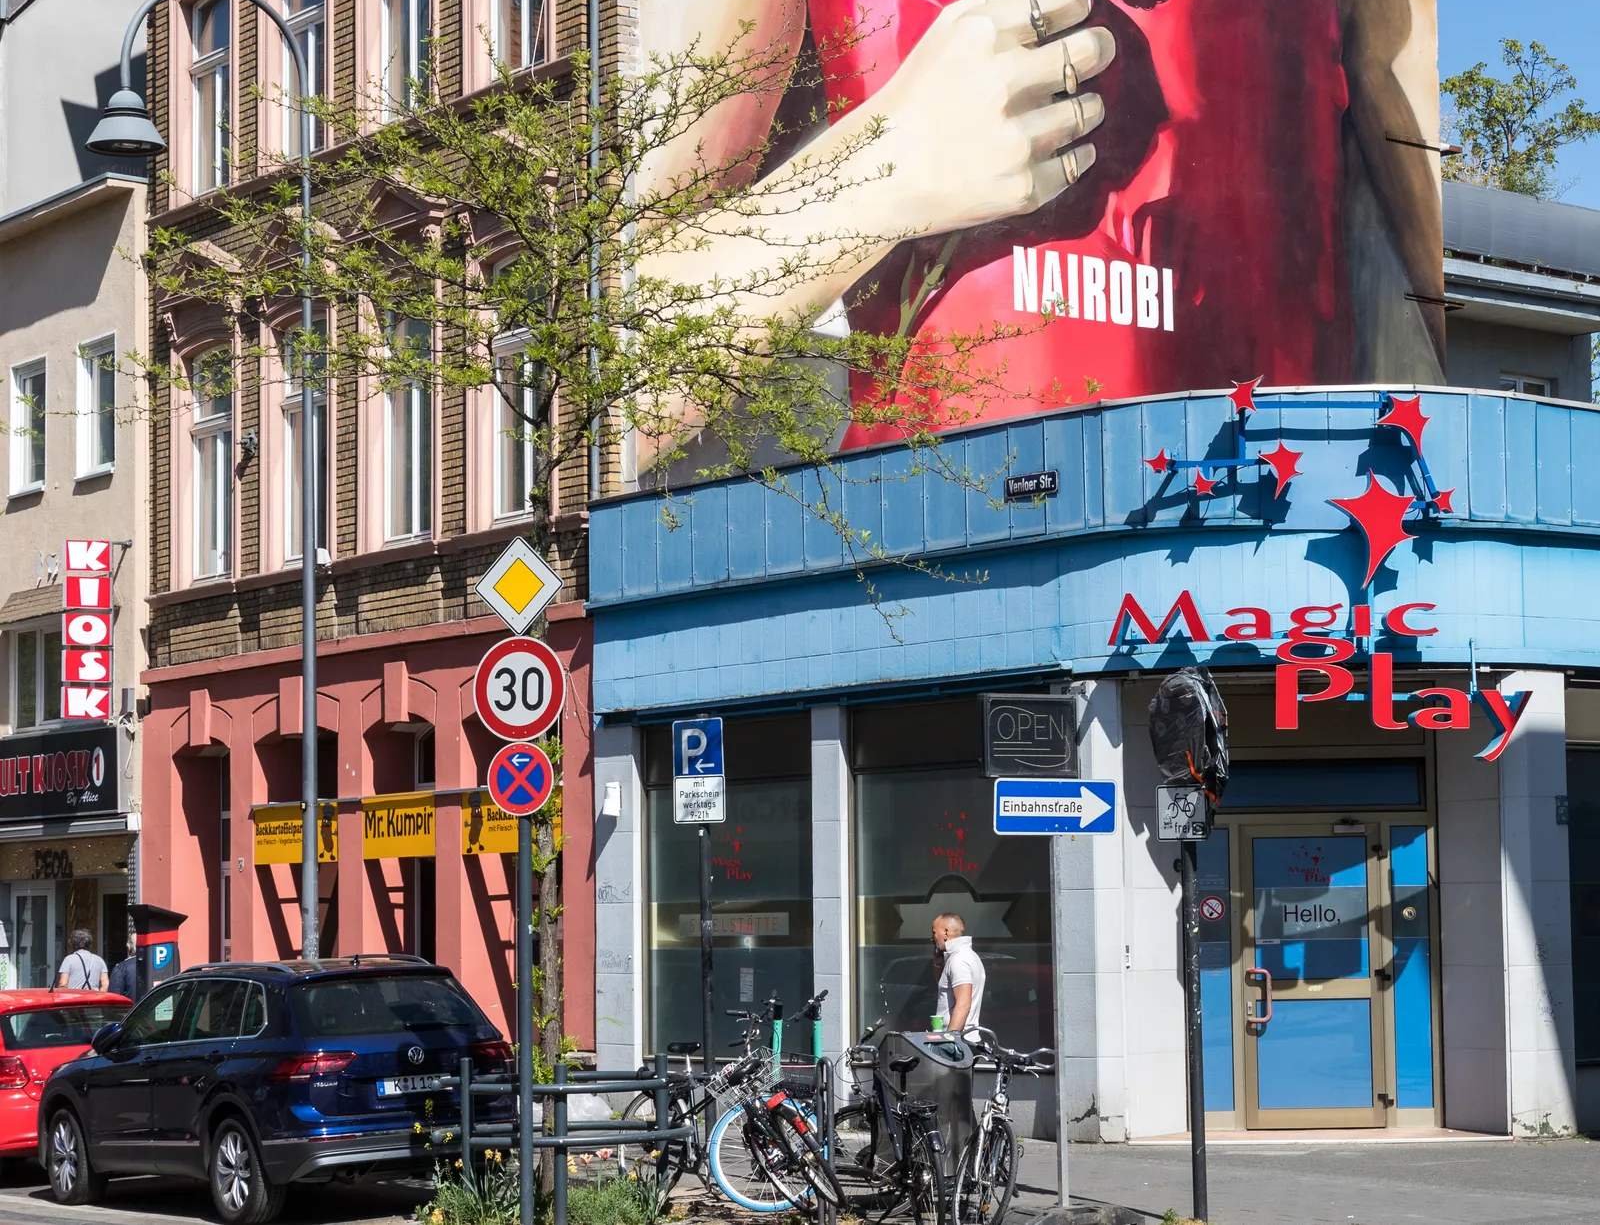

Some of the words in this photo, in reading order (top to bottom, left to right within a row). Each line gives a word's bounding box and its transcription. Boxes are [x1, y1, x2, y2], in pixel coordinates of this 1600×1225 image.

[1013, 245, 1174, 332] NAIROBI
[1008, 478, 1037, 493] Venloer
[1040, 474, 1054, 489] Str.
[67, 540, 109, 718] KIOSK
[1107, 589, 1440, 664] Magic
[494, 666, 544, 712] 30
[1275, 652, 1533, 762] Play
[997, 712, 1065, 740] OPEN
[681, 728, 707, 775] P
[33, 749, 91, 794] KIOSK
[693, 780, 705, 788] mit
[66, 791, 77, 805] By
[80, 790, 99, 803] Alice
[680, 790, 719, 799] Parkschein
[683, 800, 716, 810] werktags
[1002, 800, 1083, 814] Einbahnstraße
[365, 810, 384, 839] Mr.
[387, 807, 433, 837] Kumpir
[690, 811, 710, 819] 9-21h
[256, 821, 303, 837] Backkartoffelpar
[1174, 821, 1190, 834] frei
[1283, 904, 1340, 924] Hello,
[689, 915, 778, 933] SELSTÄTTE
